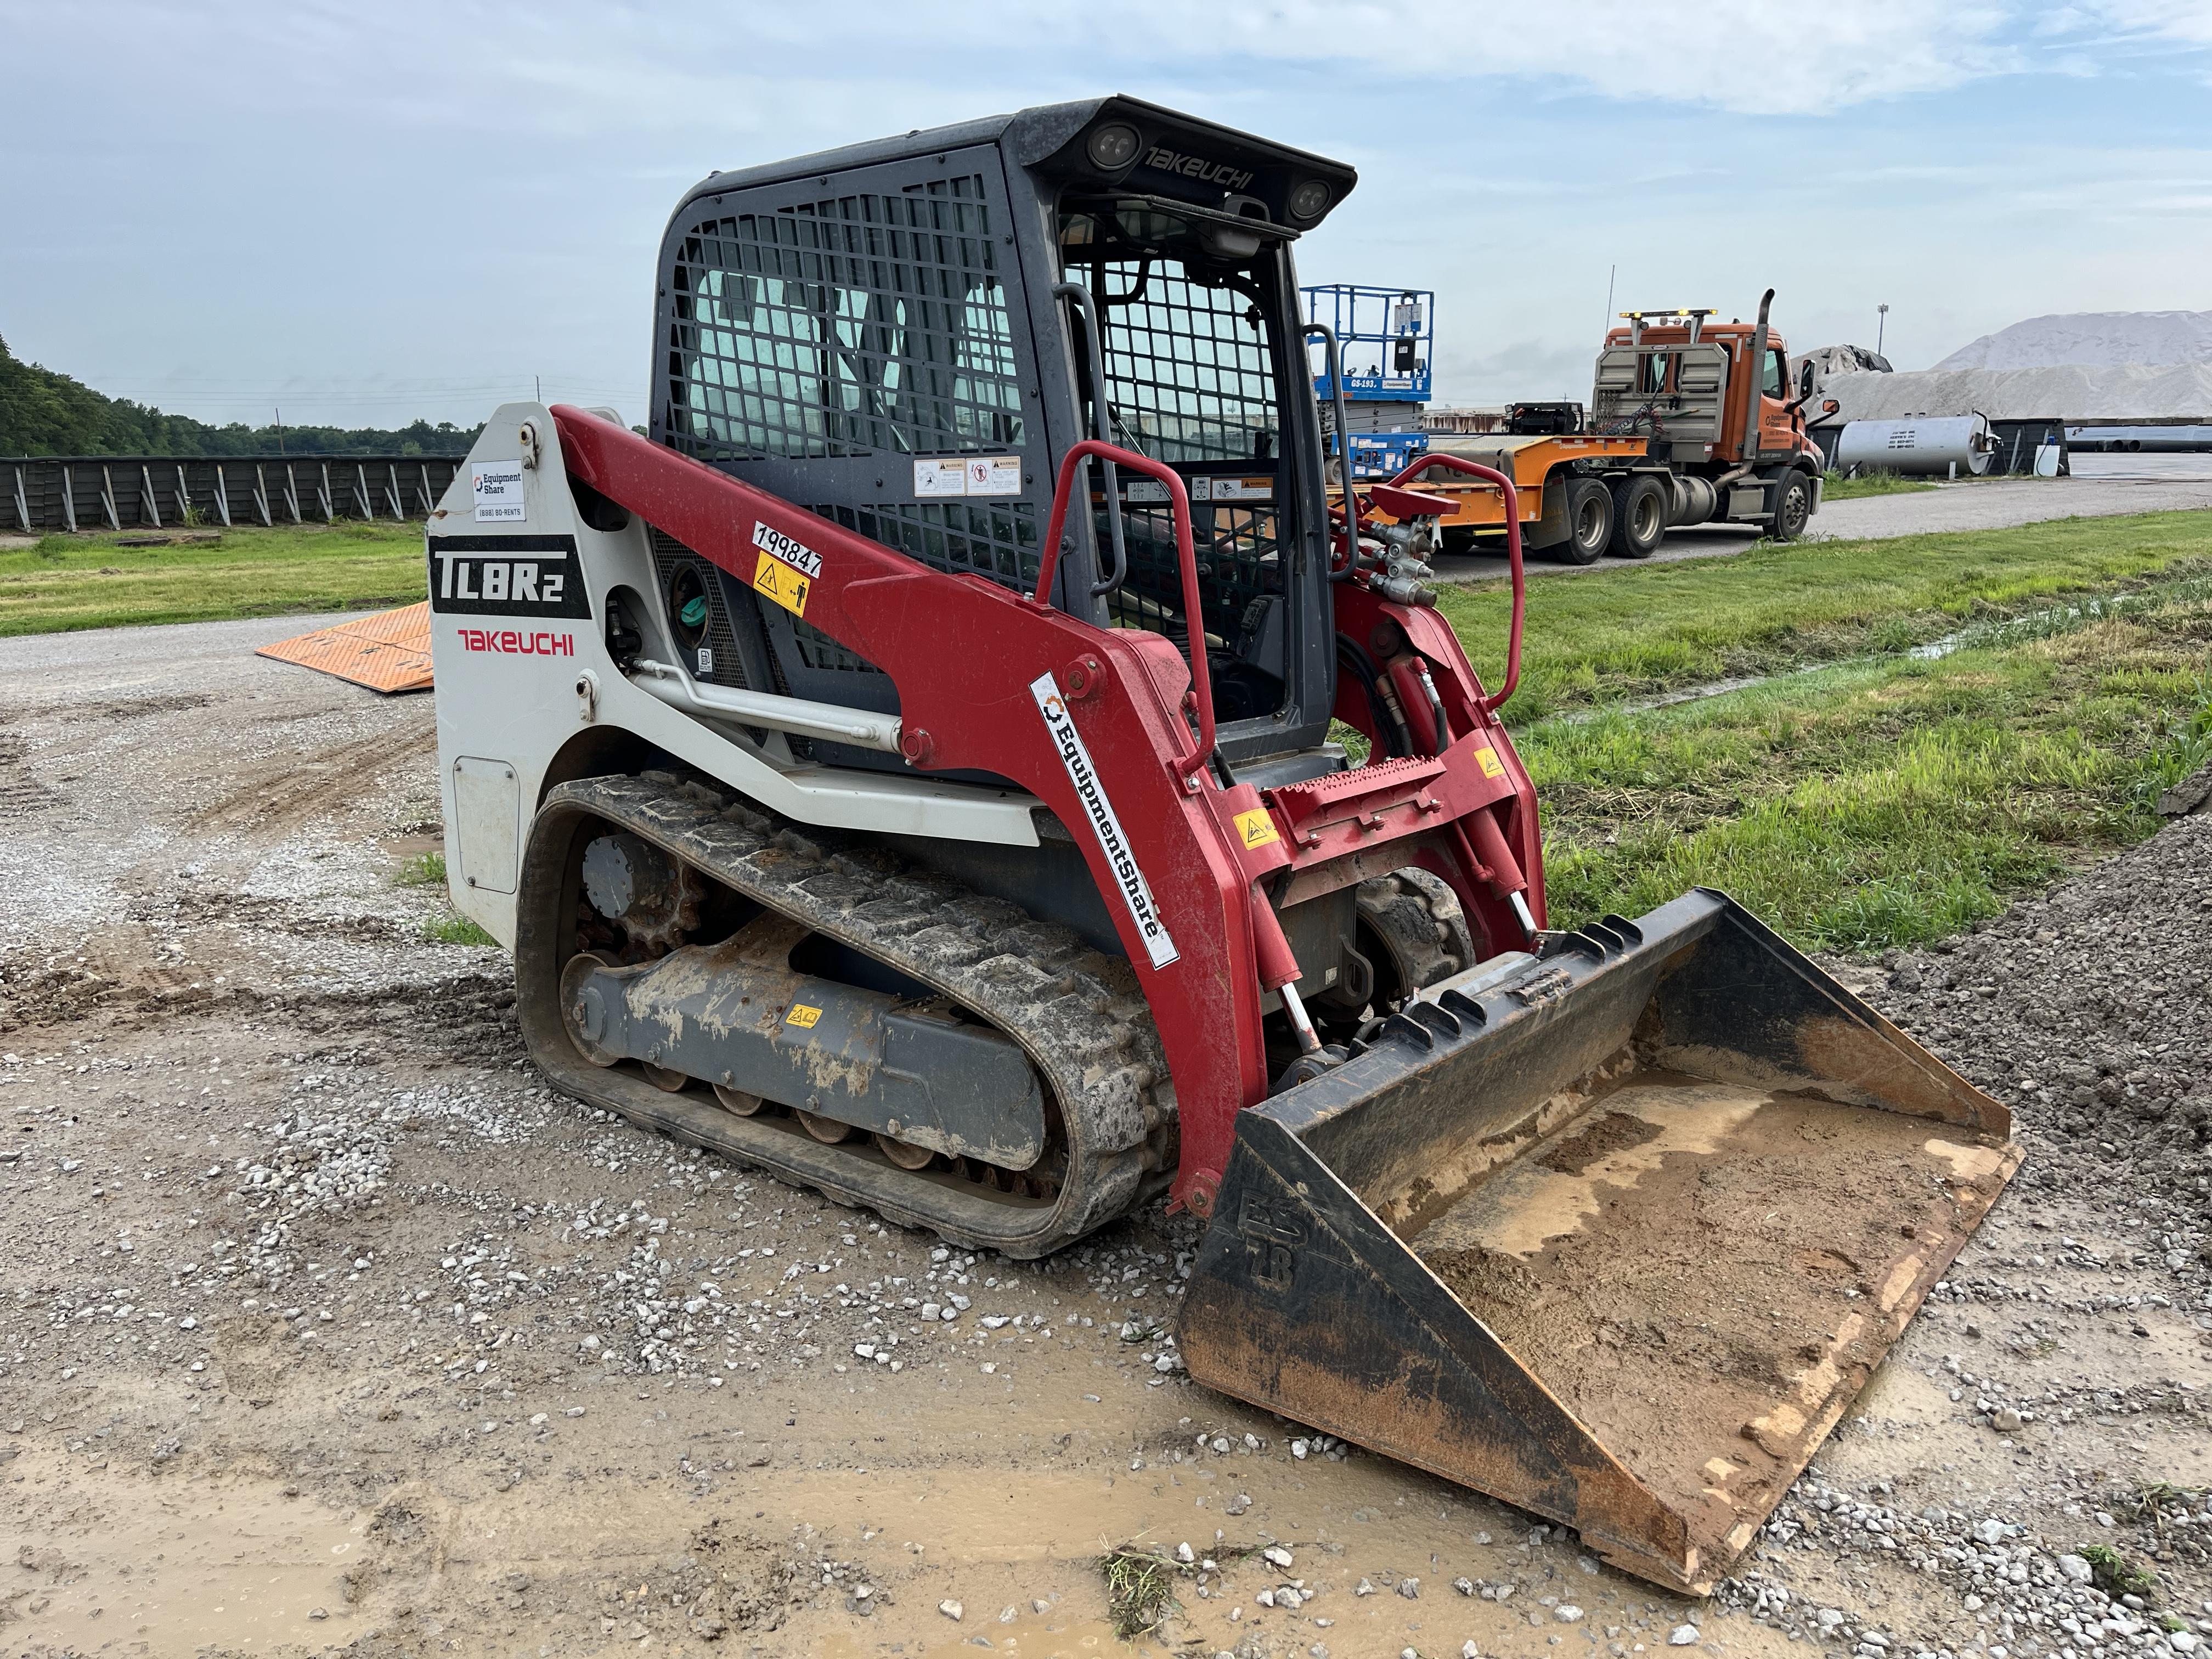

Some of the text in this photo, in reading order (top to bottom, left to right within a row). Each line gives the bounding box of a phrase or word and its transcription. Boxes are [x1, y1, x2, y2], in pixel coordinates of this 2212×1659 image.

[483, 473, 521, 484] Equipment
[484, 485, 504, 494] Share
[758, 526, 822, 574] 199847
[435, 551, 567, 602] TL8R2
[1057, 723, 1158, 938] EquipmentShare
